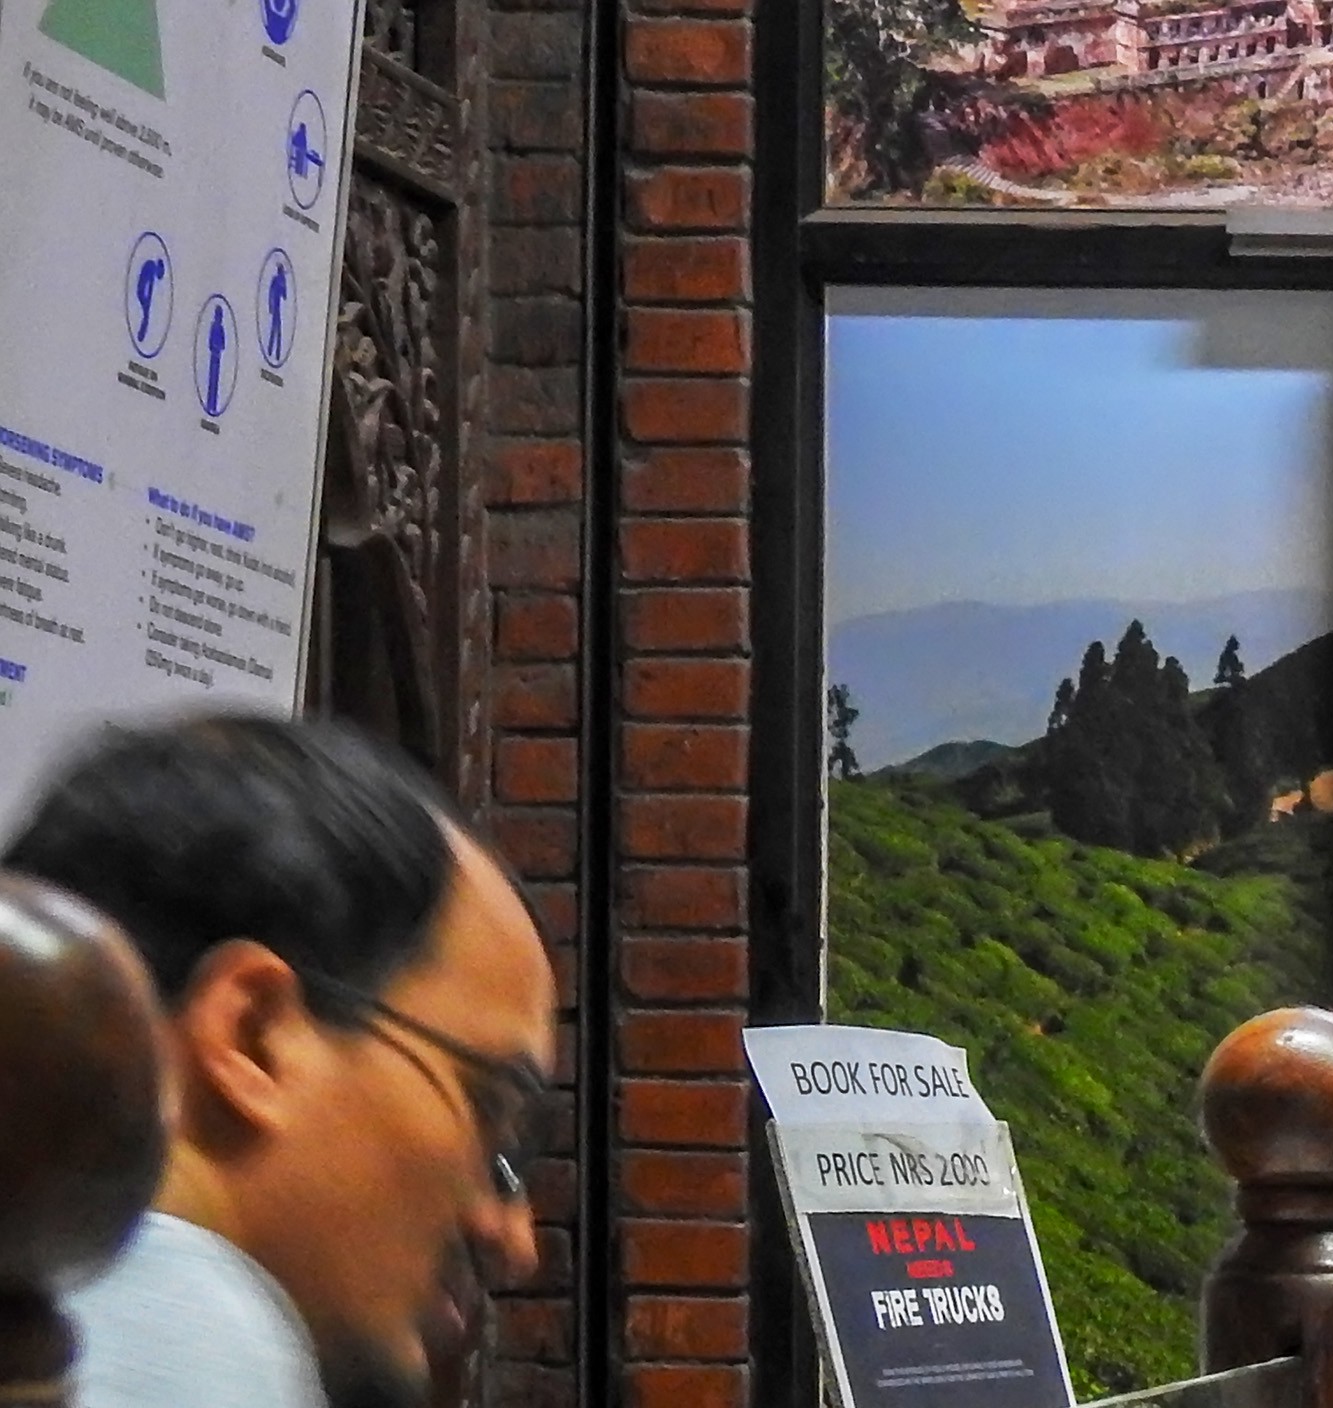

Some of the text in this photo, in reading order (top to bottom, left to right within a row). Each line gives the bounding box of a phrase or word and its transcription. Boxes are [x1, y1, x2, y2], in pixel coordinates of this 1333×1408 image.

[790, 1060, 971, 1099] BOOK FOR SALE
[816, 1152, 991, 1187] PRICE NRS 2000
[866, 1217, 977, 1255] NEPAL
[871, 1284, 1006, 1330] FIRE TRUCKS
